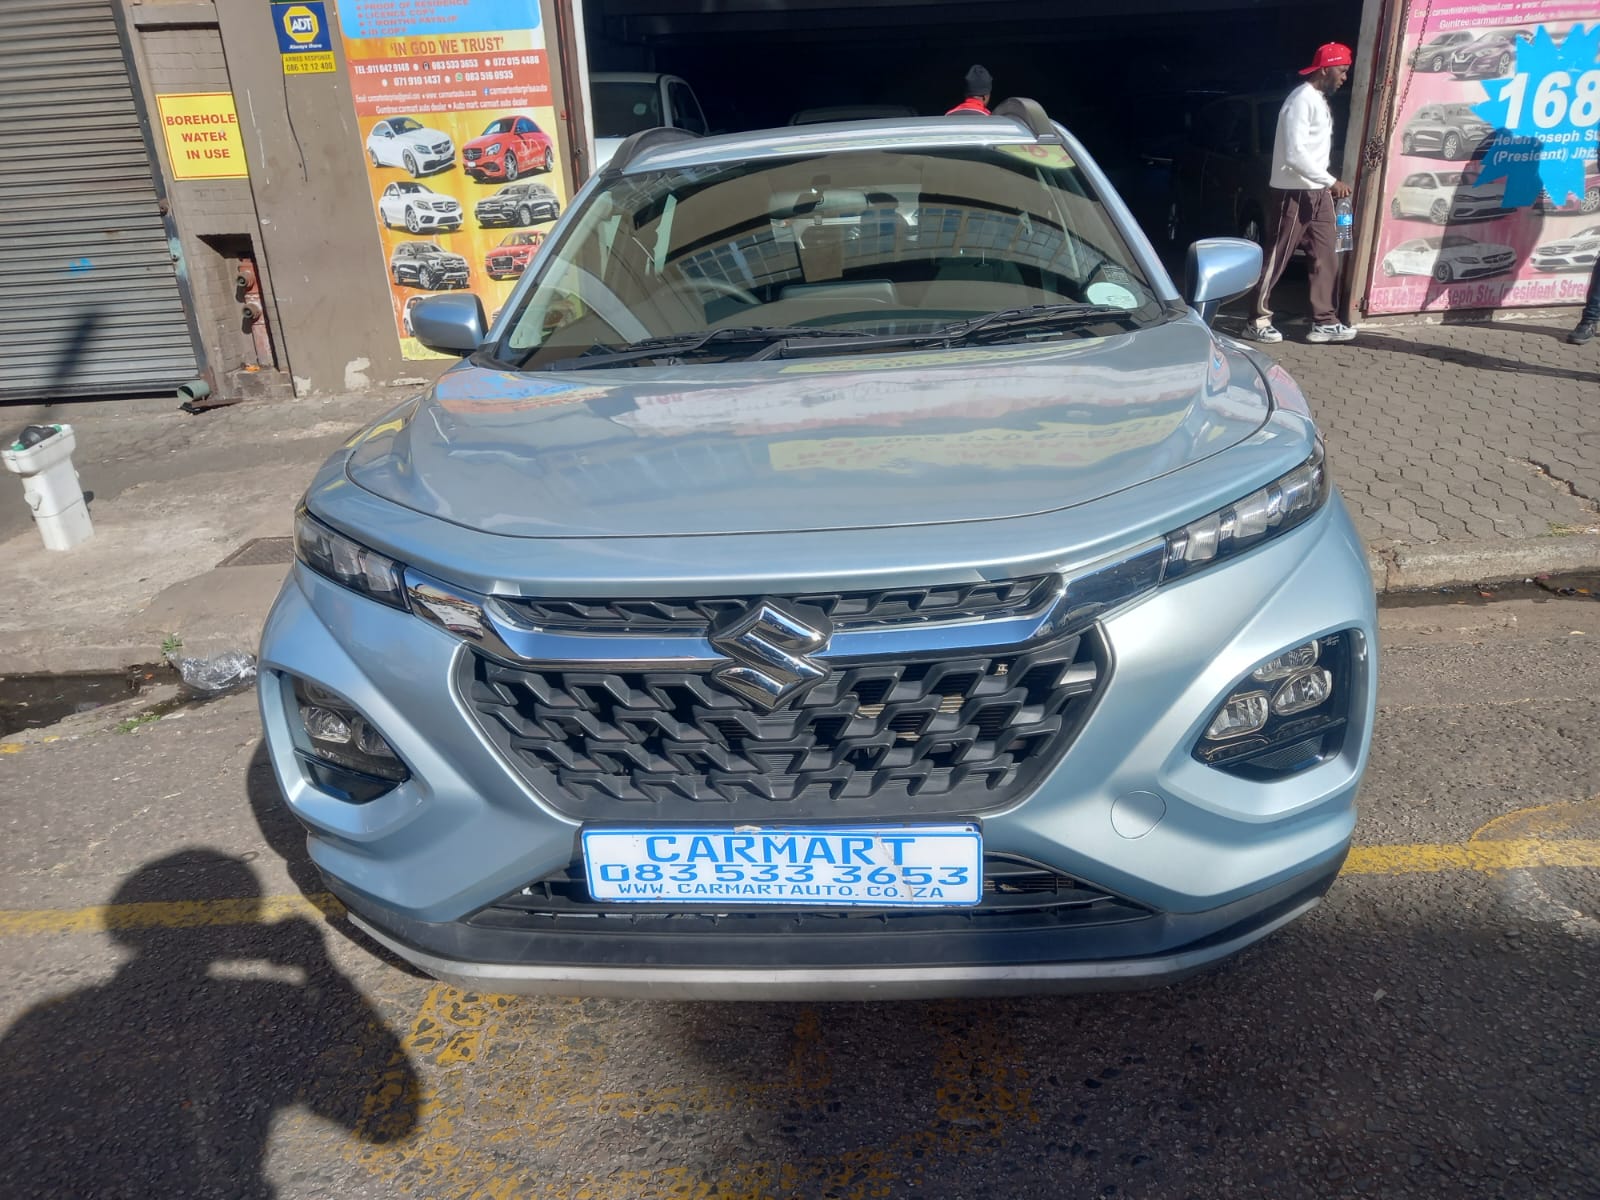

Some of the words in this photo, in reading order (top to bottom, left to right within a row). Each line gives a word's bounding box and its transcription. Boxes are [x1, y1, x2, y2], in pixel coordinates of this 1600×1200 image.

[291, 17, 312, 31] ADT
[411, 40, 435, 54] GOD
[440, 39, 459, 53] WE
[301, 63, 308, 71] 12
[311, 62, 319, 71] 12
[1498, 69, 1600, 130] 168
[166, 113, 236, 126] BOREHOLE
[181, 132, 227, 142] WATER
[1493, 133, 1531, 146] Helen
[186, 150, 200, 159] IN
[204, 149, 231, 159] USE
[1493, 147, 1569, 166] (President)
[646, 836, 915, 866] CARMART
[600, 863, 698, 882] 083
[715, 864, 814, 883] 533
[832, 866, 968, 886] 3653
[618, 883, 944, 899] WWW.CARMARTAUTO.CO.ZA
